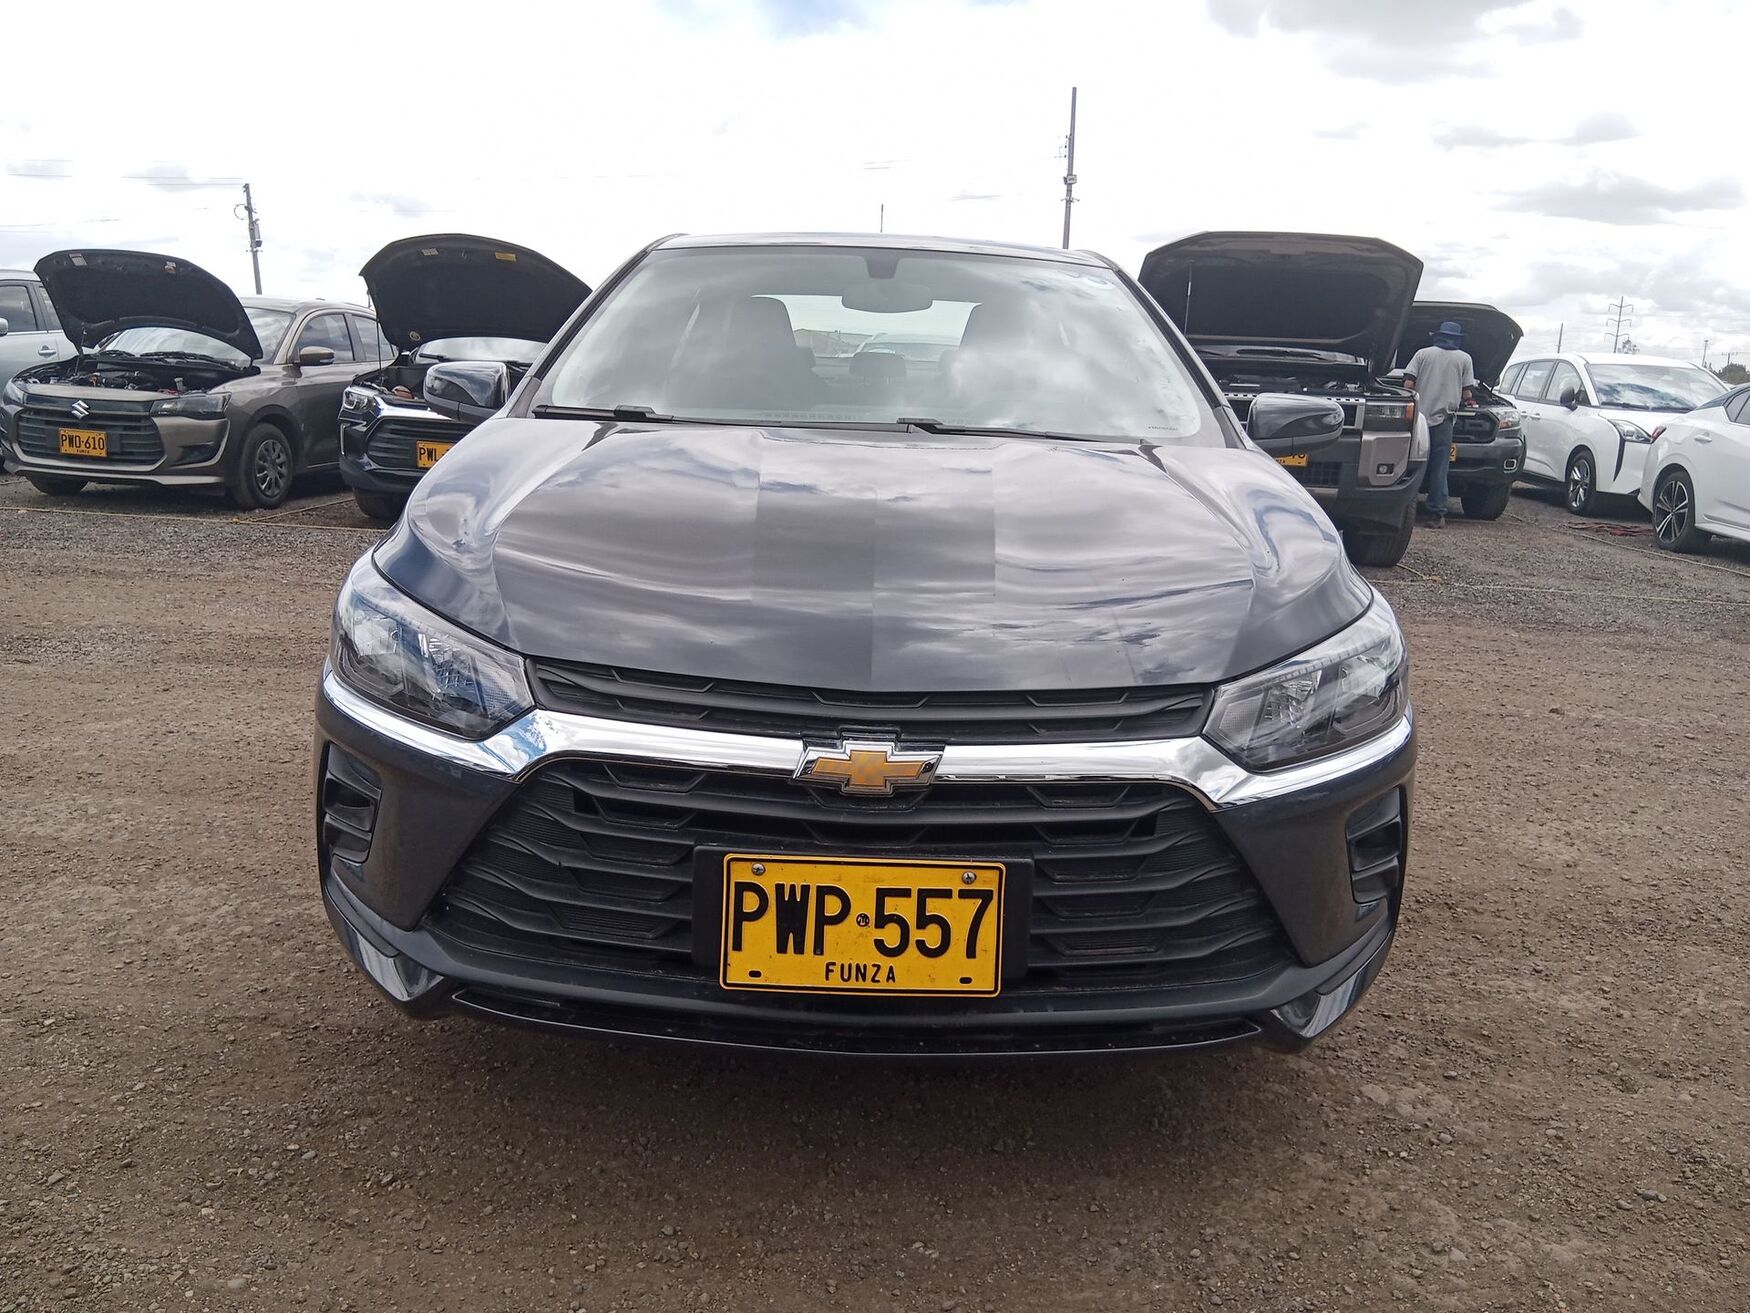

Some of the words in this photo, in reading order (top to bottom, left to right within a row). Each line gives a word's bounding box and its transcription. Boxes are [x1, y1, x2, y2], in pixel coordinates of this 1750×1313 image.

[84, 436, 105, 450] 610
[731, 881, 852, 955] PWP
[873, 887, 994, 959] 557
[825, 961, 896, 983] FUNZA
